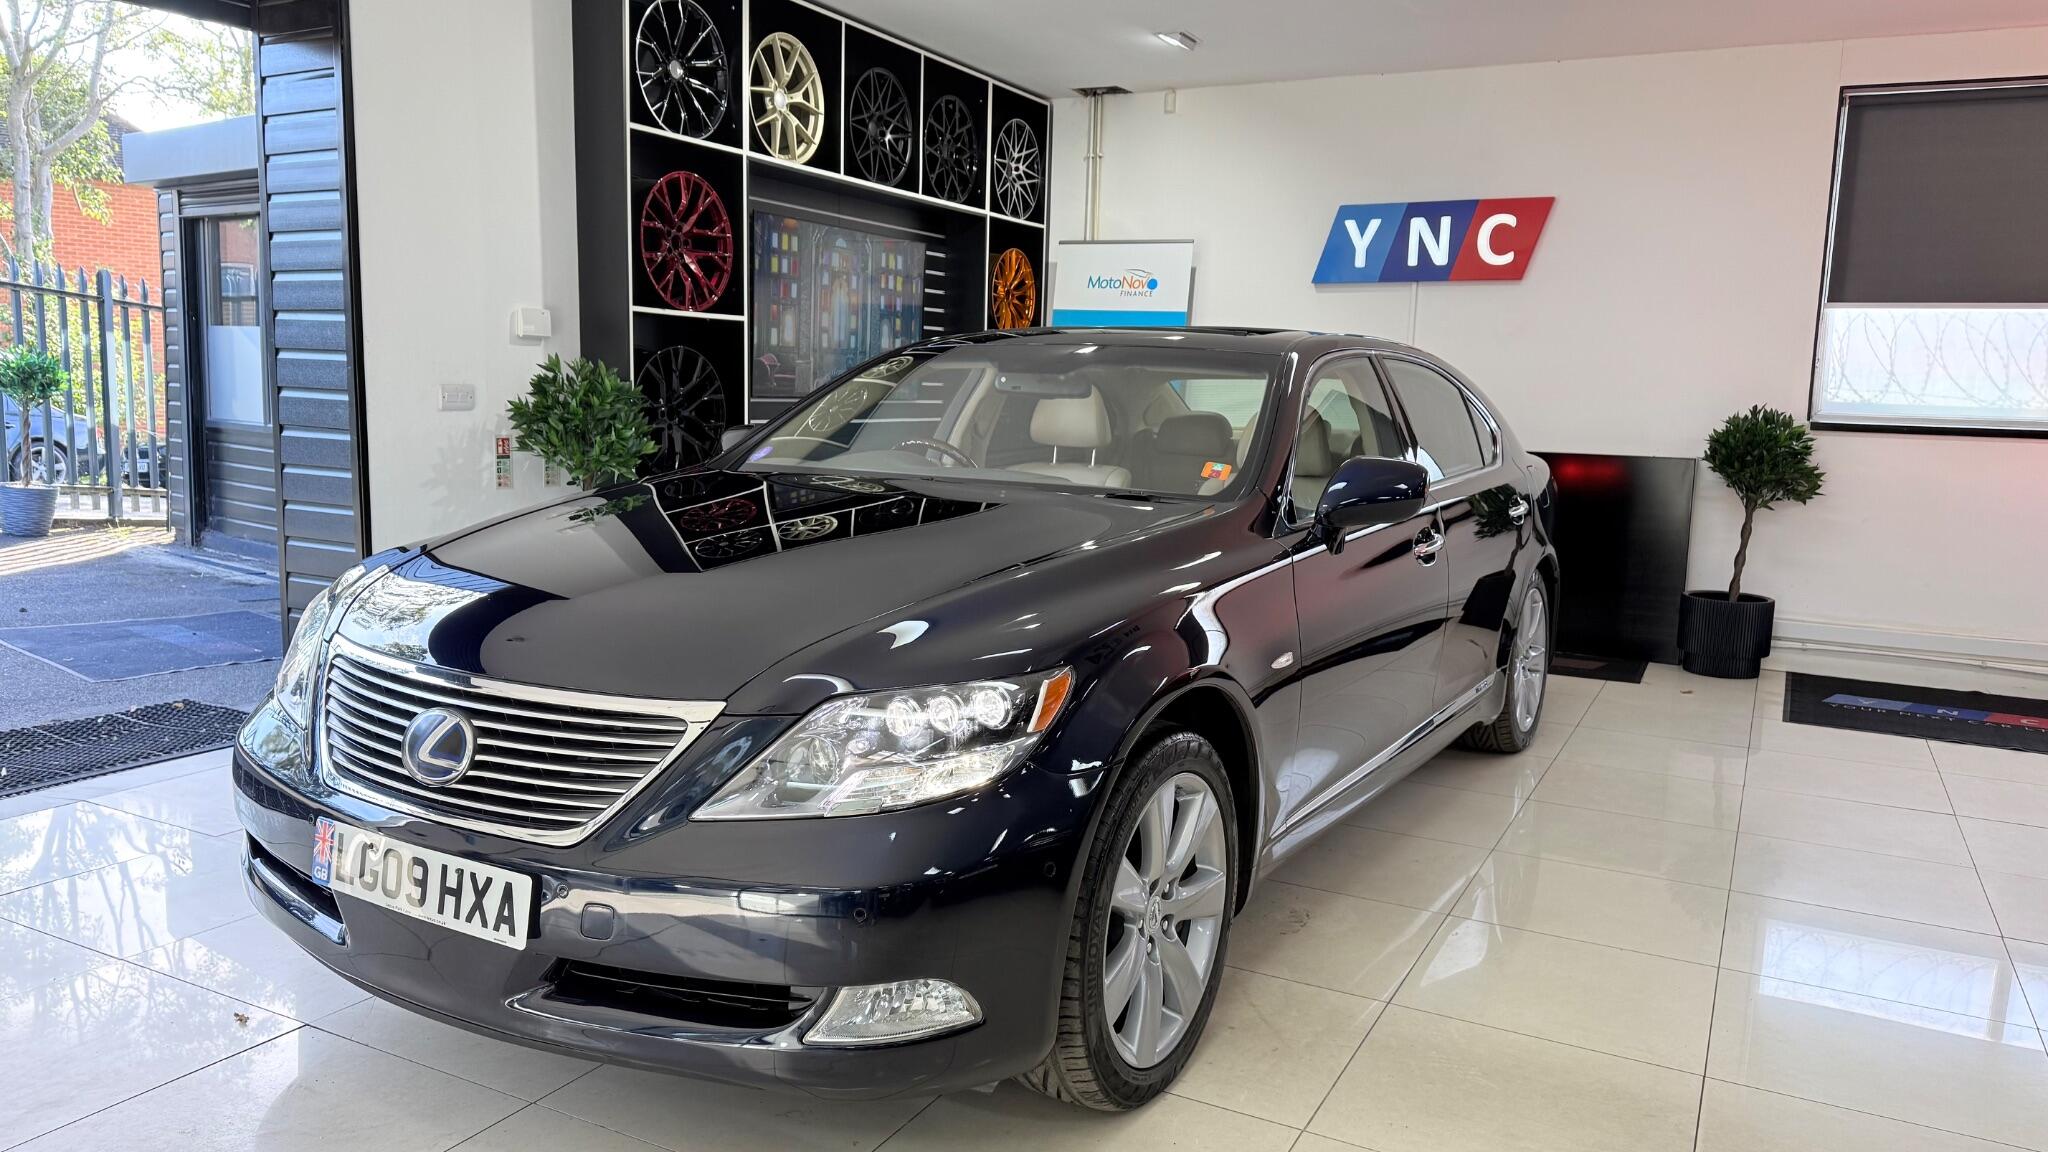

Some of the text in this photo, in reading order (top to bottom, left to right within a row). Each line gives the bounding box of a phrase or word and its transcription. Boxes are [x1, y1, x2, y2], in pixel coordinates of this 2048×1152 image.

[1344, 213, 1517, 268] YNC
[314, 866, 328, 881] GB
[335, 832, 516, 938] LG09 HXA
